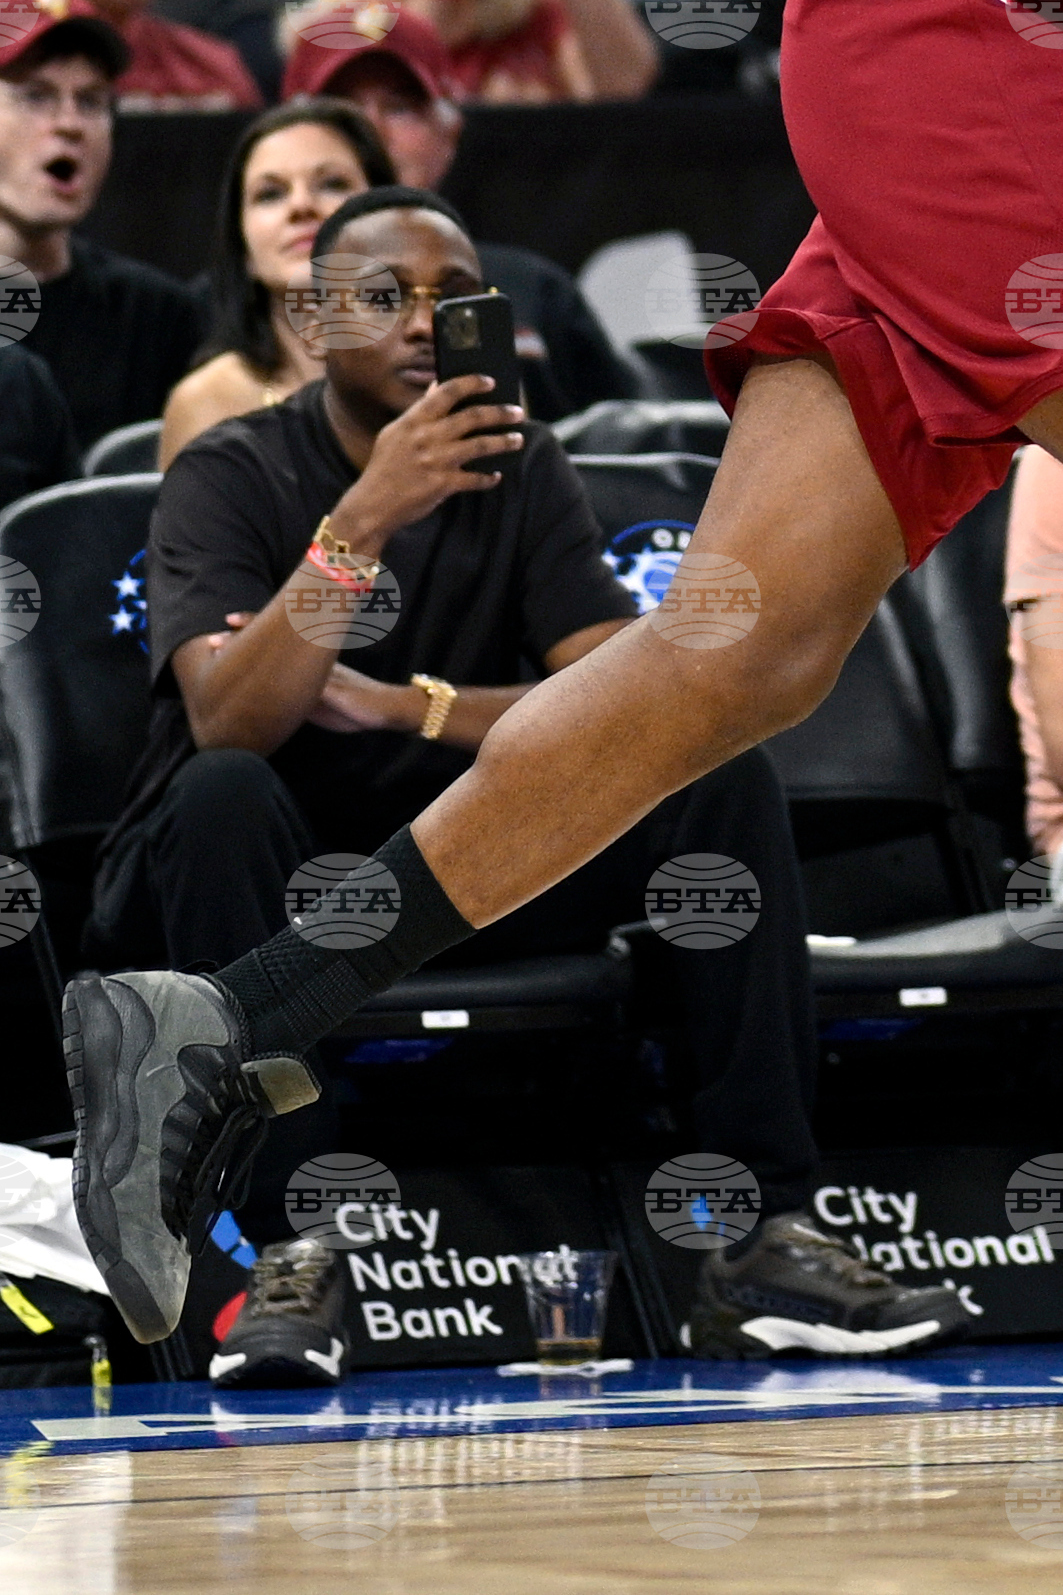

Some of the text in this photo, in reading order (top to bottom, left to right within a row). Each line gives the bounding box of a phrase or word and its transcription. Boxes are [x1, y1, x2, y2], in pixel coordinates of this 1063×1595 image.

[335, 1202, 440, 1251] City
[814, 1186, 918, 1234] City
[361, 1298, 503, 1341] Bank
